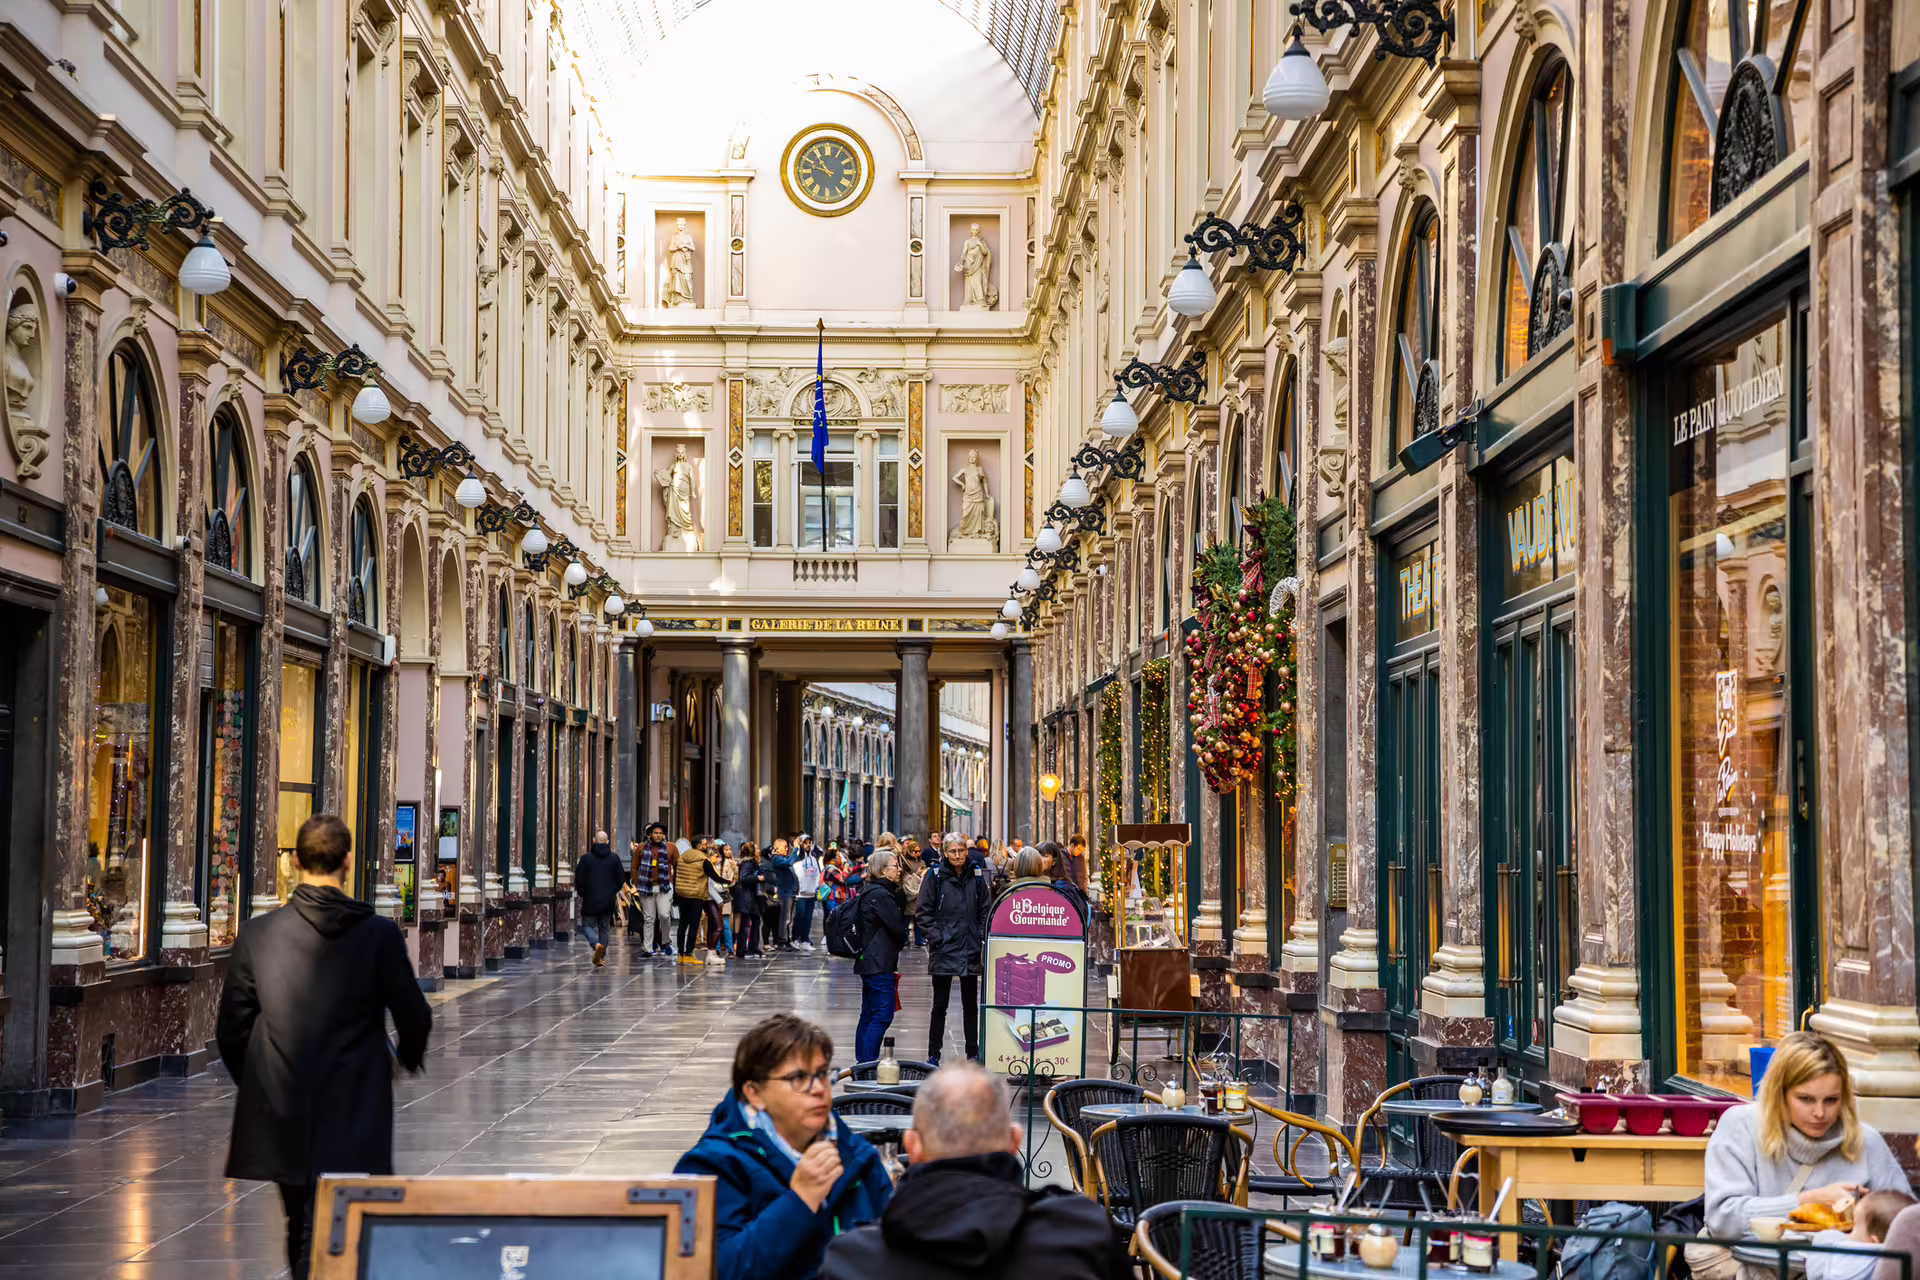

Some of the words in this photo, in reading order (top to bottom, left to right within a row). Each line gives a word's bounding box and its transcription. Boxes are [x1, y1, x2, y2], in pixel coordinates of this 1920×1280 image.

[1673, 412, 1687, 446] LE
[1689, 398, 1715, 439] PAIN
[1718, 365, 1784, 425] QUOTIDIEN
[751, 619, 811, 630] GALERIE
[814, 619, 832, 630] DE
[836, 619, 853, 630] LA
[856, 619, 900, 630] REINE
[1703, 821, 1725, 860] Happy
[1725, 823, 1756, 863] Holidays
[1012, 899, 1021, 909] la
[1021, 898, 1065, 916] Belgique
[1009, 909, 1068, 926] Gourmande
[1041, 955, 1072, 970] PROMO
[1021, 1056, 1041, 1064] fre
[1054, 1057, 1070, 1065] 30€
